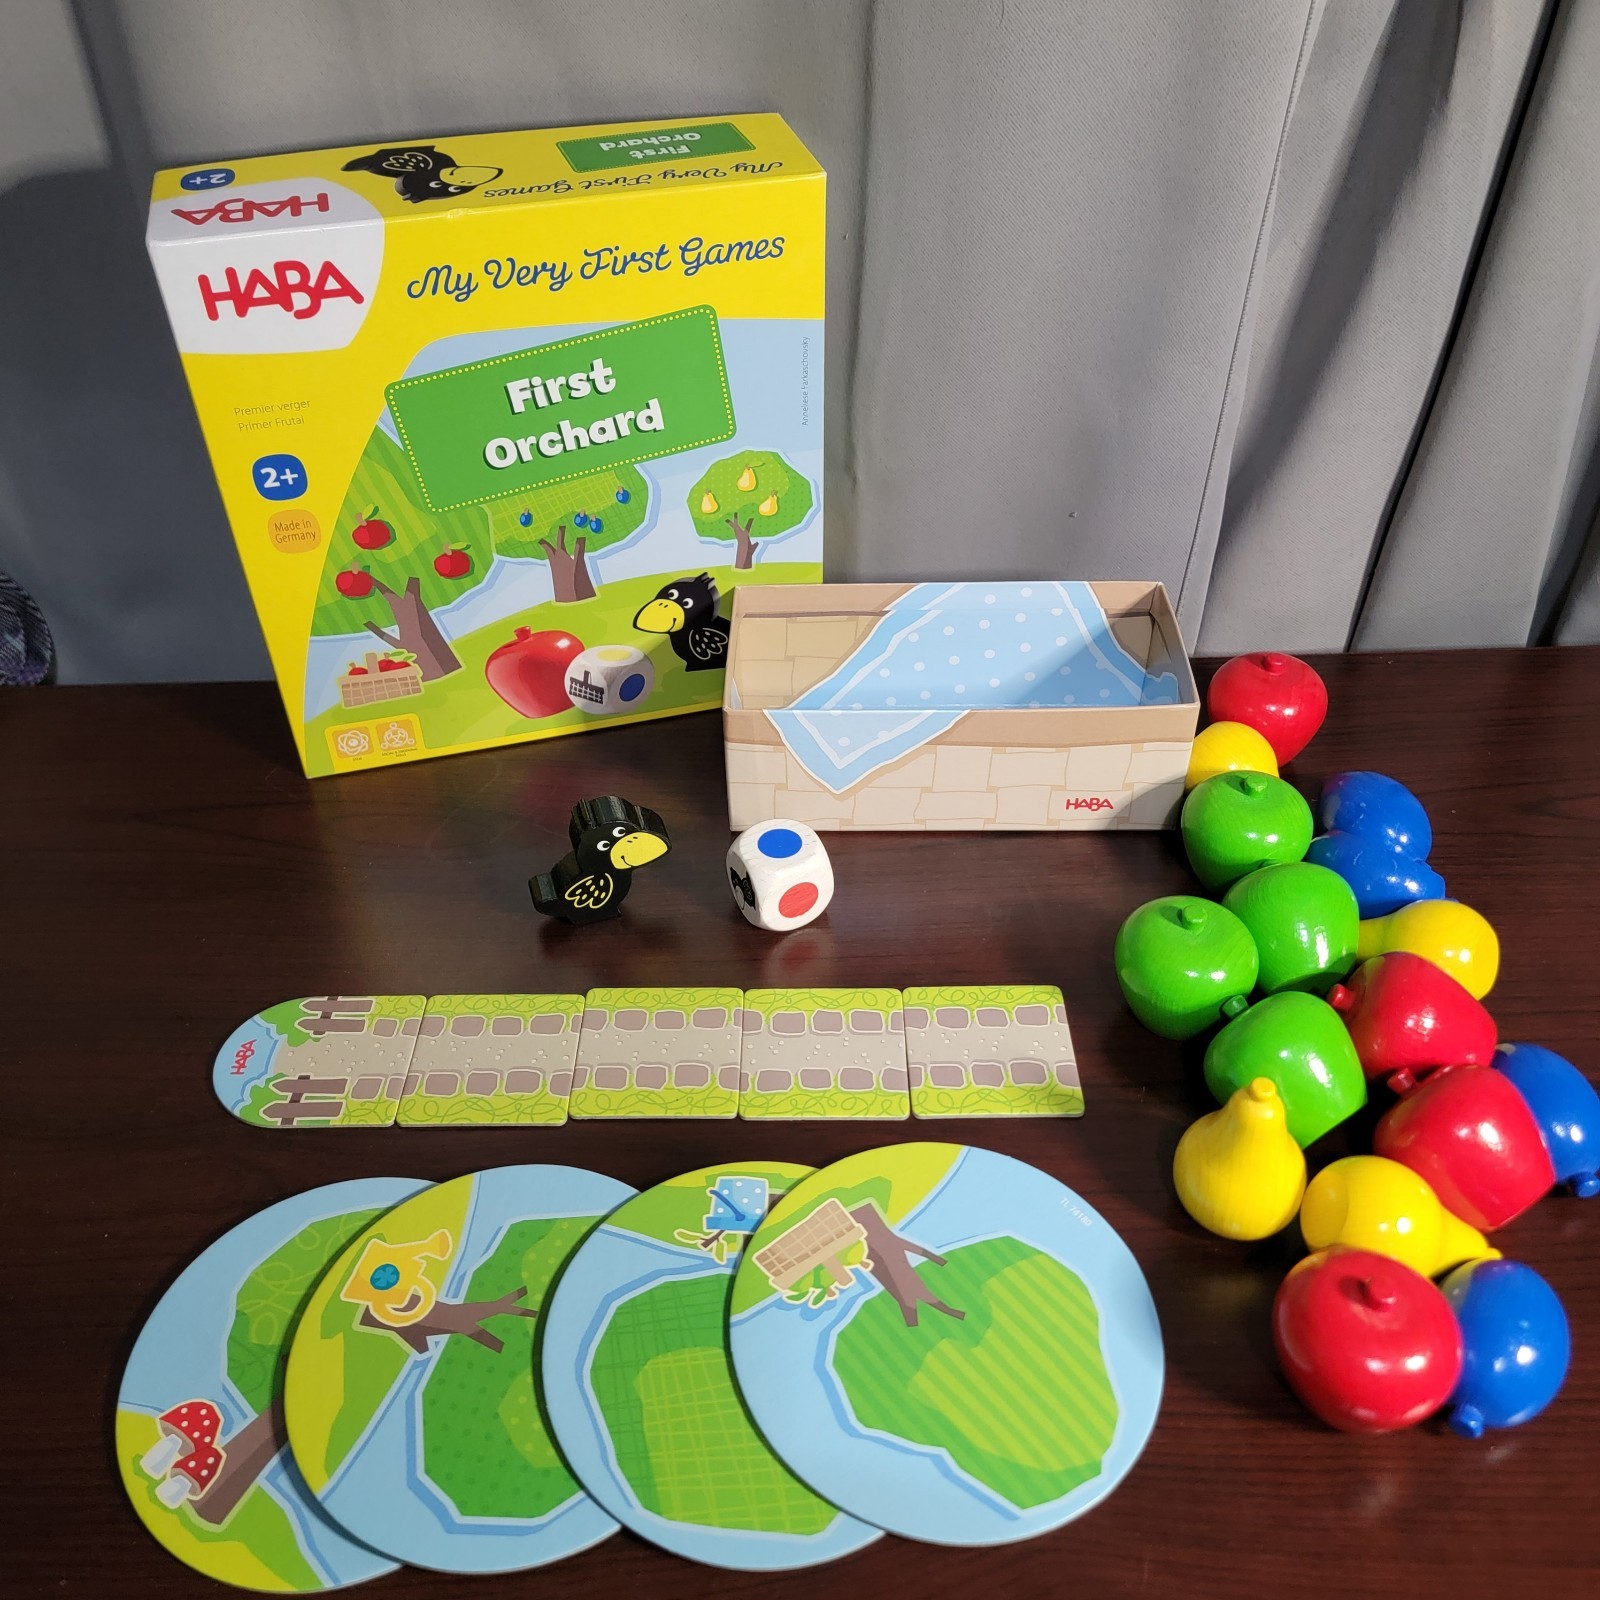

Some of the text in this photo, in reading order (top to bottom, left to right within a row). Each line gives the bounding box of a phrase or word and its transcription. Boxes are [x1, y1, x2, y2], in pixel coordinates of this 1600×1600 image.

[598, 132, 701, 151] Orchard
[629, 145, 690, 159] First
[188, 172, 226, 186] 2+
[483, 161, 783, 199] My Very First Games
[170, 192, 330, 226] HABA
[407, 236, 786, 302] My Very First Games
[197, 260, 365, 321] HABA
[505, 357, 617, 414] First
[234, 400, 311, 417] Premier verger
[238, 415, 305, 432] Primer Frutal
[483, 398, 665, 470] Orchard
[260, 467, 299, 489] 2+
[274, 518, 312, 533] Made in
[275, 530, 316, 544] Germany
[1065, 797, 1114, 812] HABA
[230, 1039, 257, 1075] HABA
